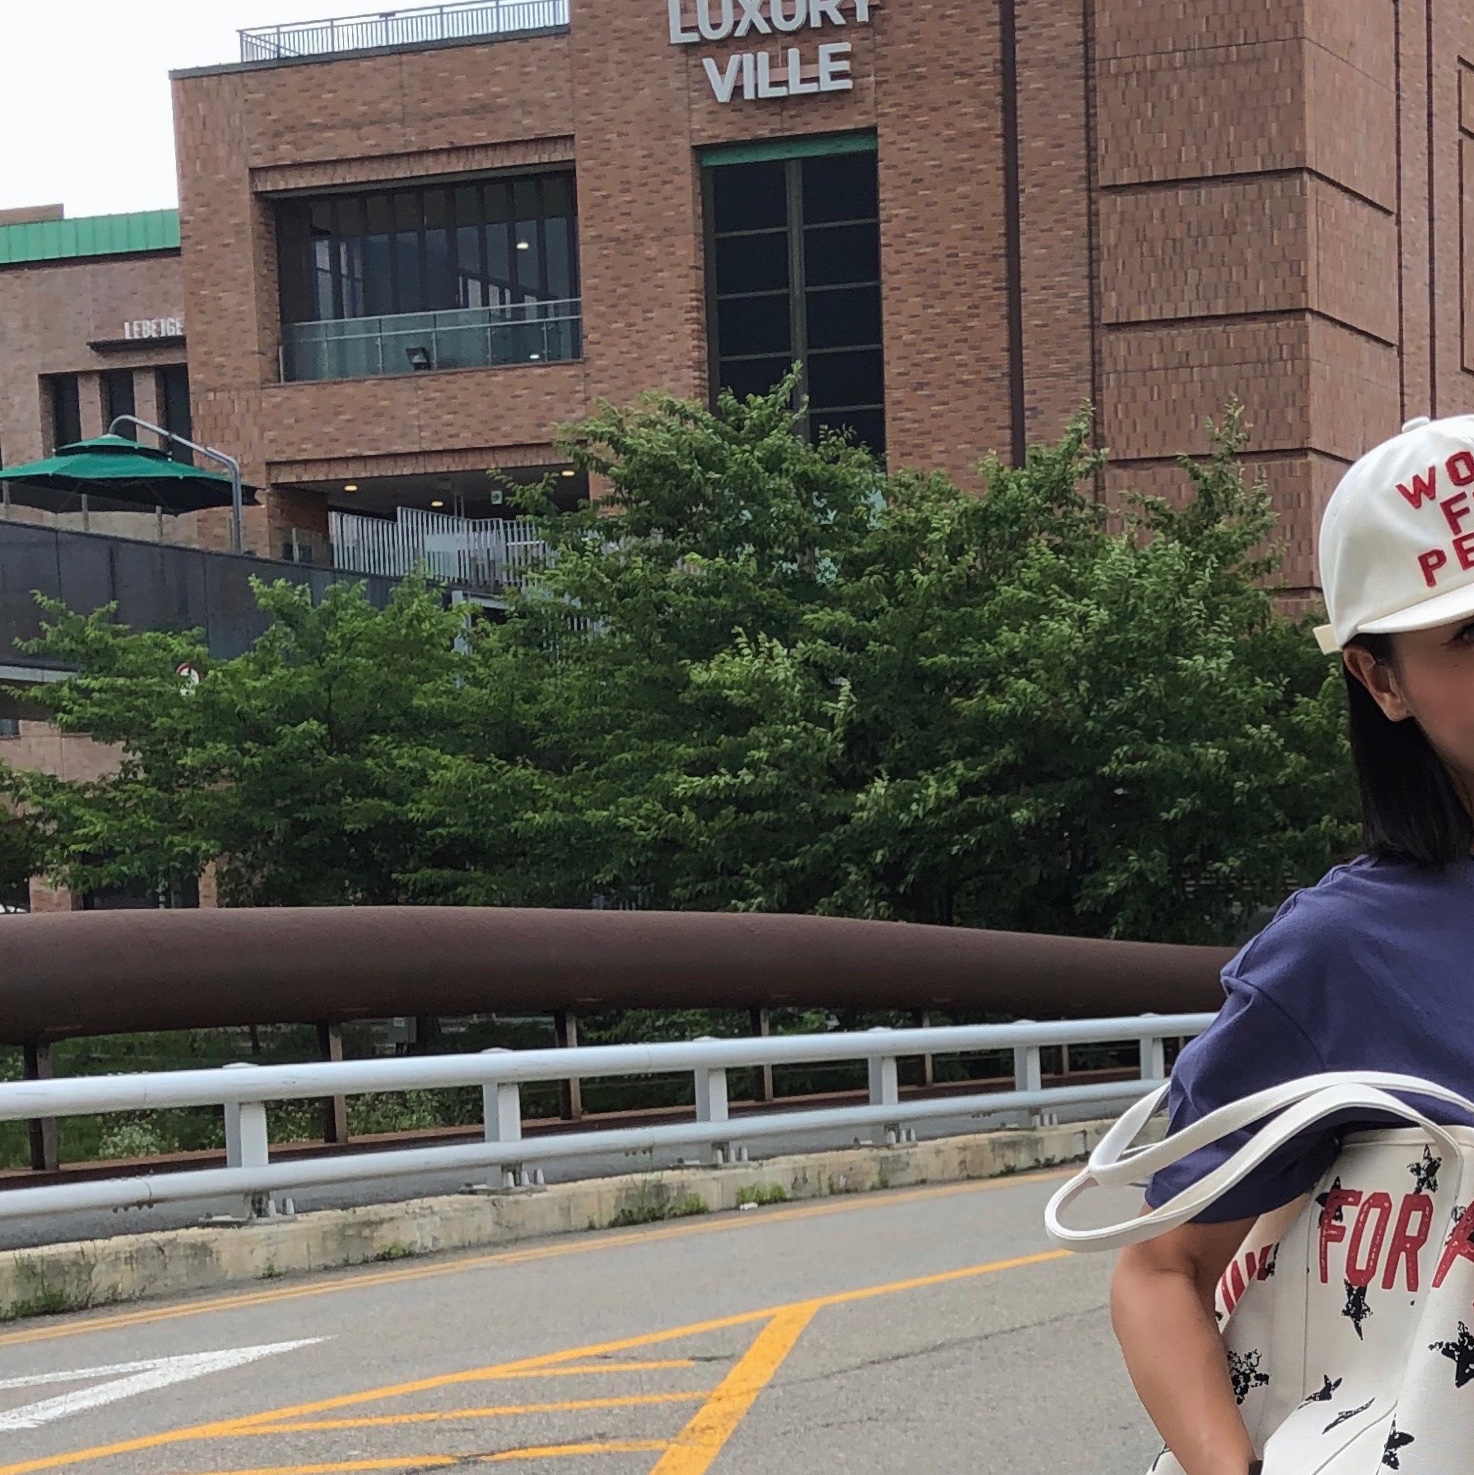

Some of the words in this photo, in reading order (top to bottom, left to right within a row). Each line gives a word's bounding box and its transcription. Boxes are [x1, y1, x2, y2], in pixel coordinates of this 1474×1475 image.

[702, 41, 853, 103] VILLE
[124, 317, 183, 340] LEBEIGE
[1317, 1188, 1434, 1292] FOR
